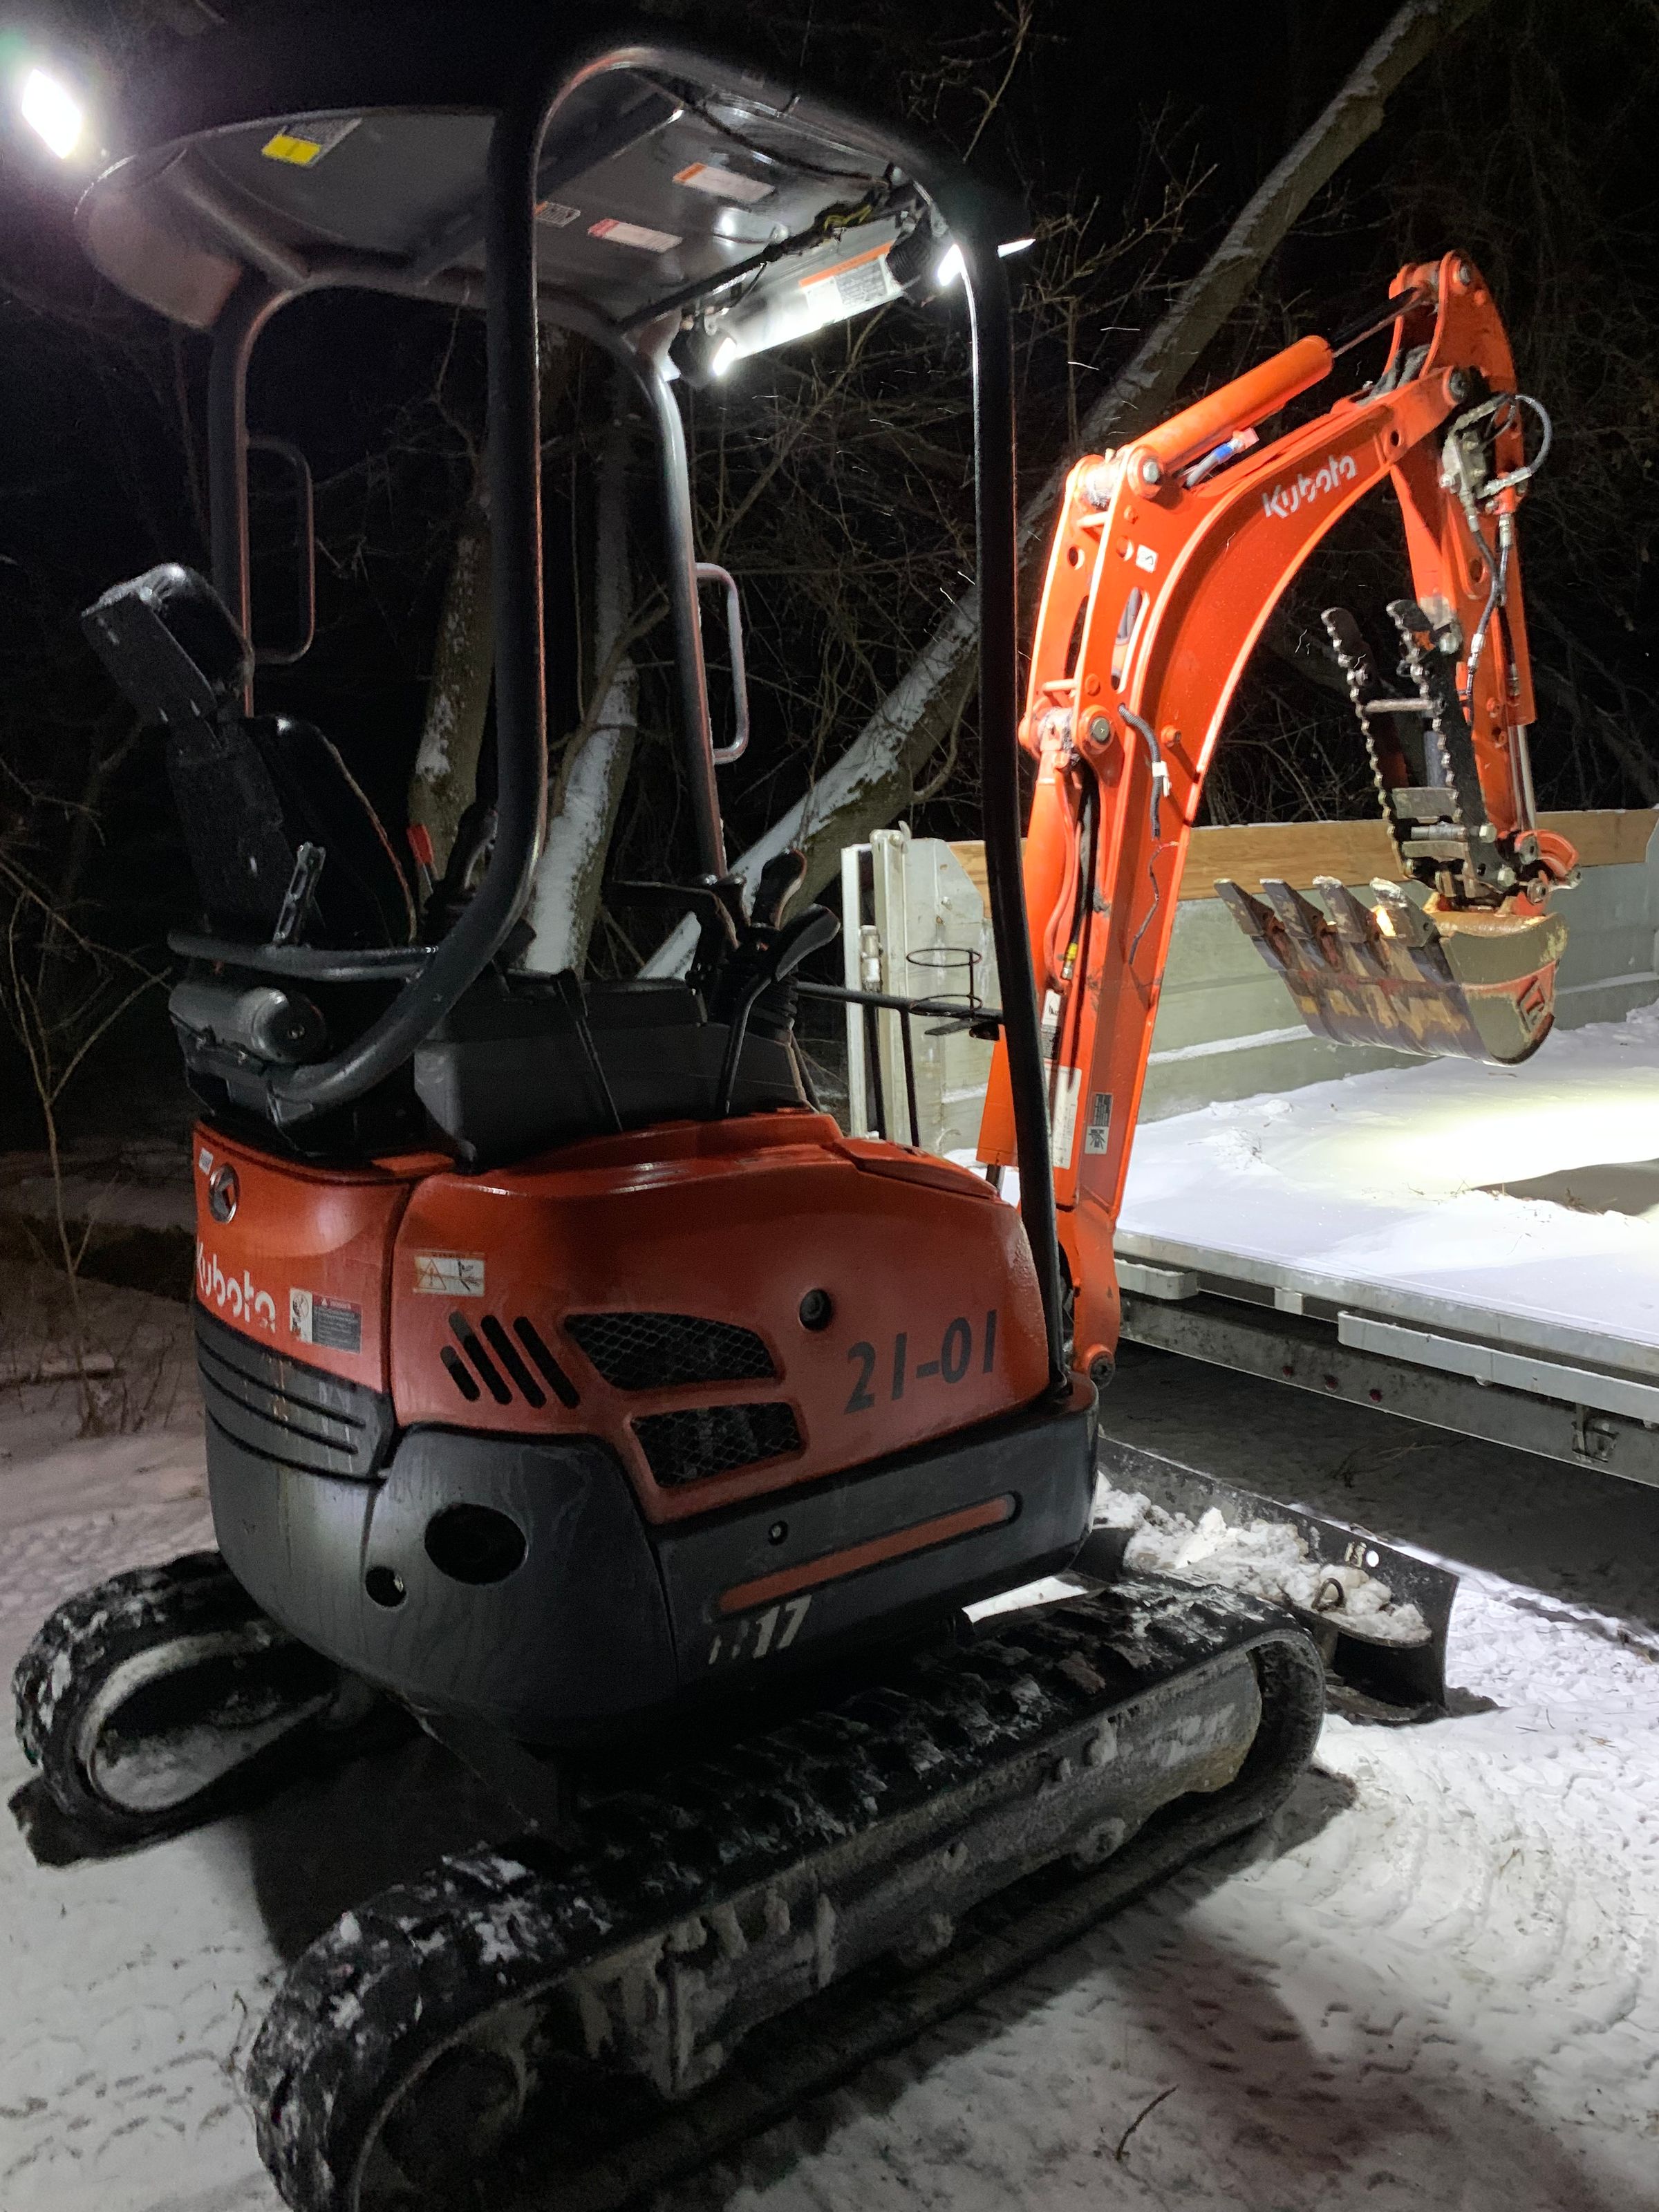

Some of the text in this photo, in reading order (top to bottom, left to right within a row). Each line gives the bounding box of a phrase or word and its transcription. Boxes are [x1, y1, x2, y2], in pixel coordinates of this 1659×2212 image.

[1262, 455, 1356, 518] Kubota
[196, 1240, 276, 1333] Kubota
[844, 1309, 997, 1415] 21-01
